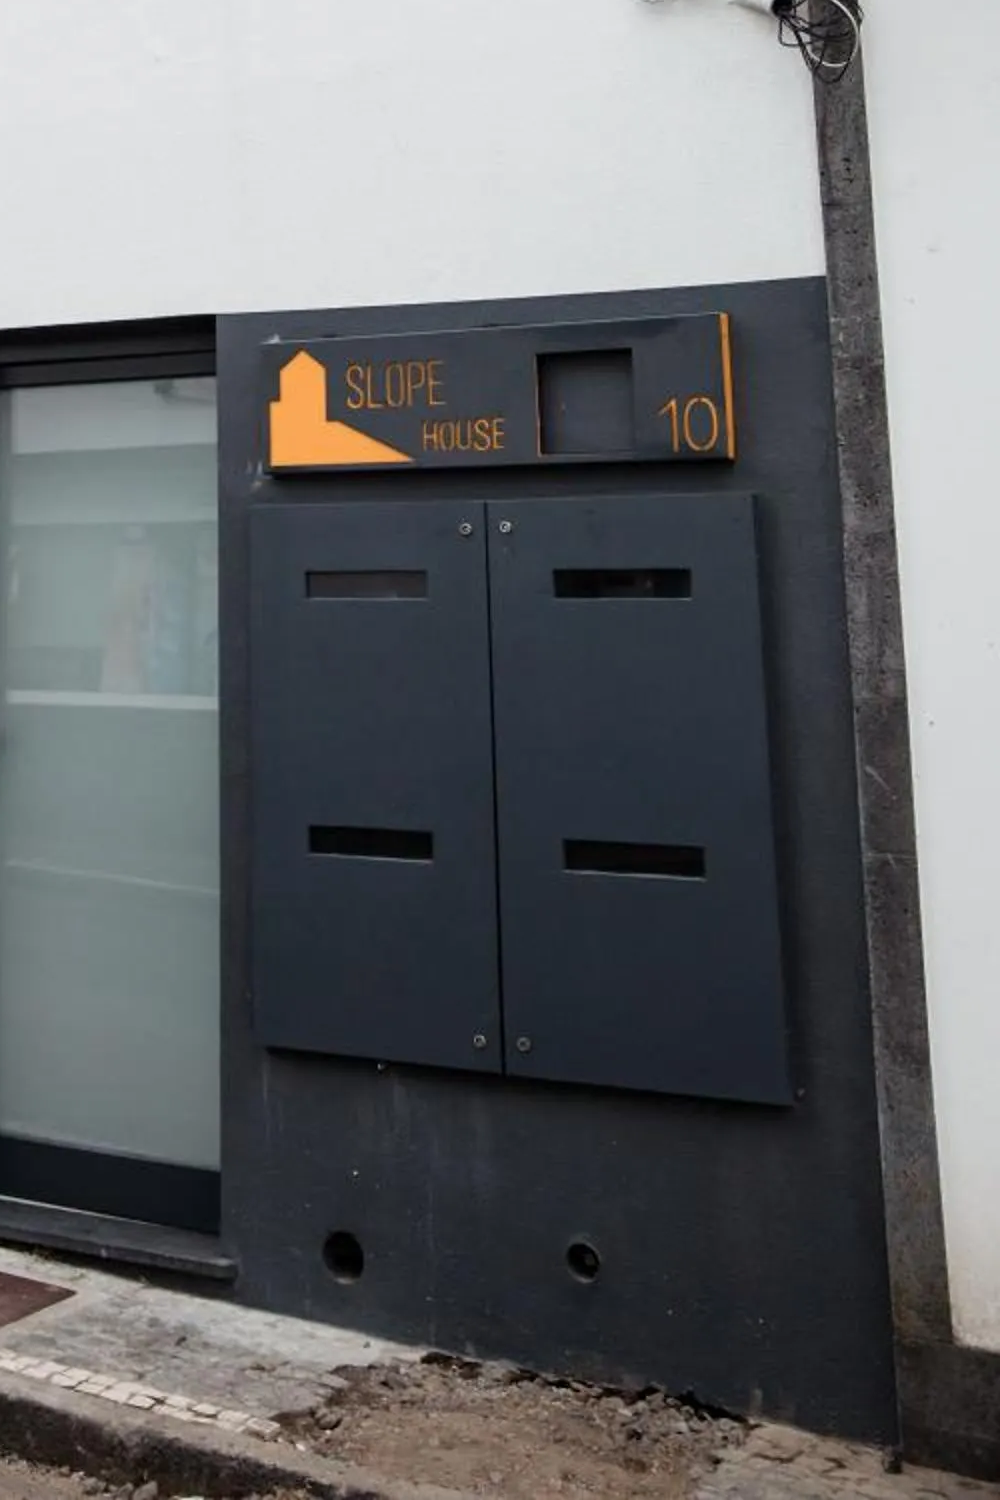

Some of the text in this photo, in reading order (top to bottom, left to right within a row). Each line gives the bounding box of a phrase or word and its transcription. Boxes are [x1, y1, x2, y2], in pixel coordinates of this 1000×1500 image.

[344, 360, 446, 409] SLOPE
[422, 417, 505, 452] HOUSE
[657, 396, 719, 453] 10
